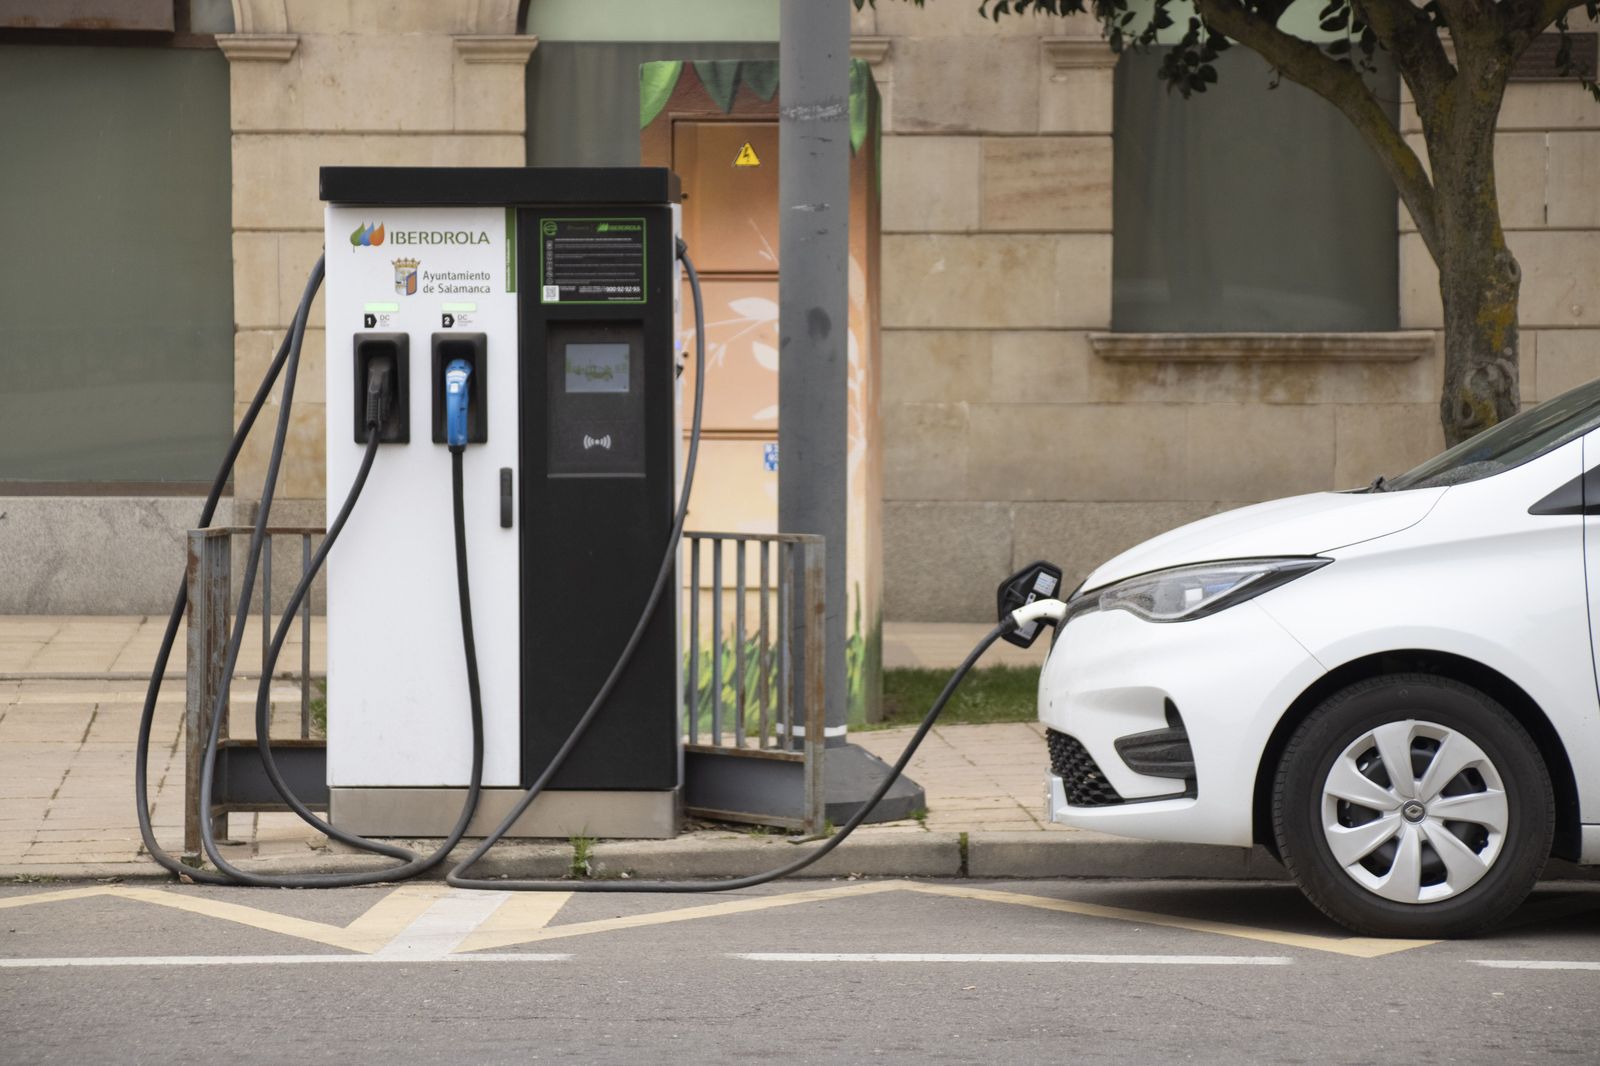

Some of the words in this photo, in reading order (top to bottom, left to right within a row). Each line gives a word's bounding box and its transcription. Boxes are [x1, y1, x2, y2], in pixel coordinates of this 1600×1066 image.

[390, 231, 490, 245] IBERDROLA
[423, 270, 491, 282] Ayuntamiento
[423, 284, 435, 294] de
[438, 283, 491, 294] Salamanca
[444, 316, 451, 326] 2
